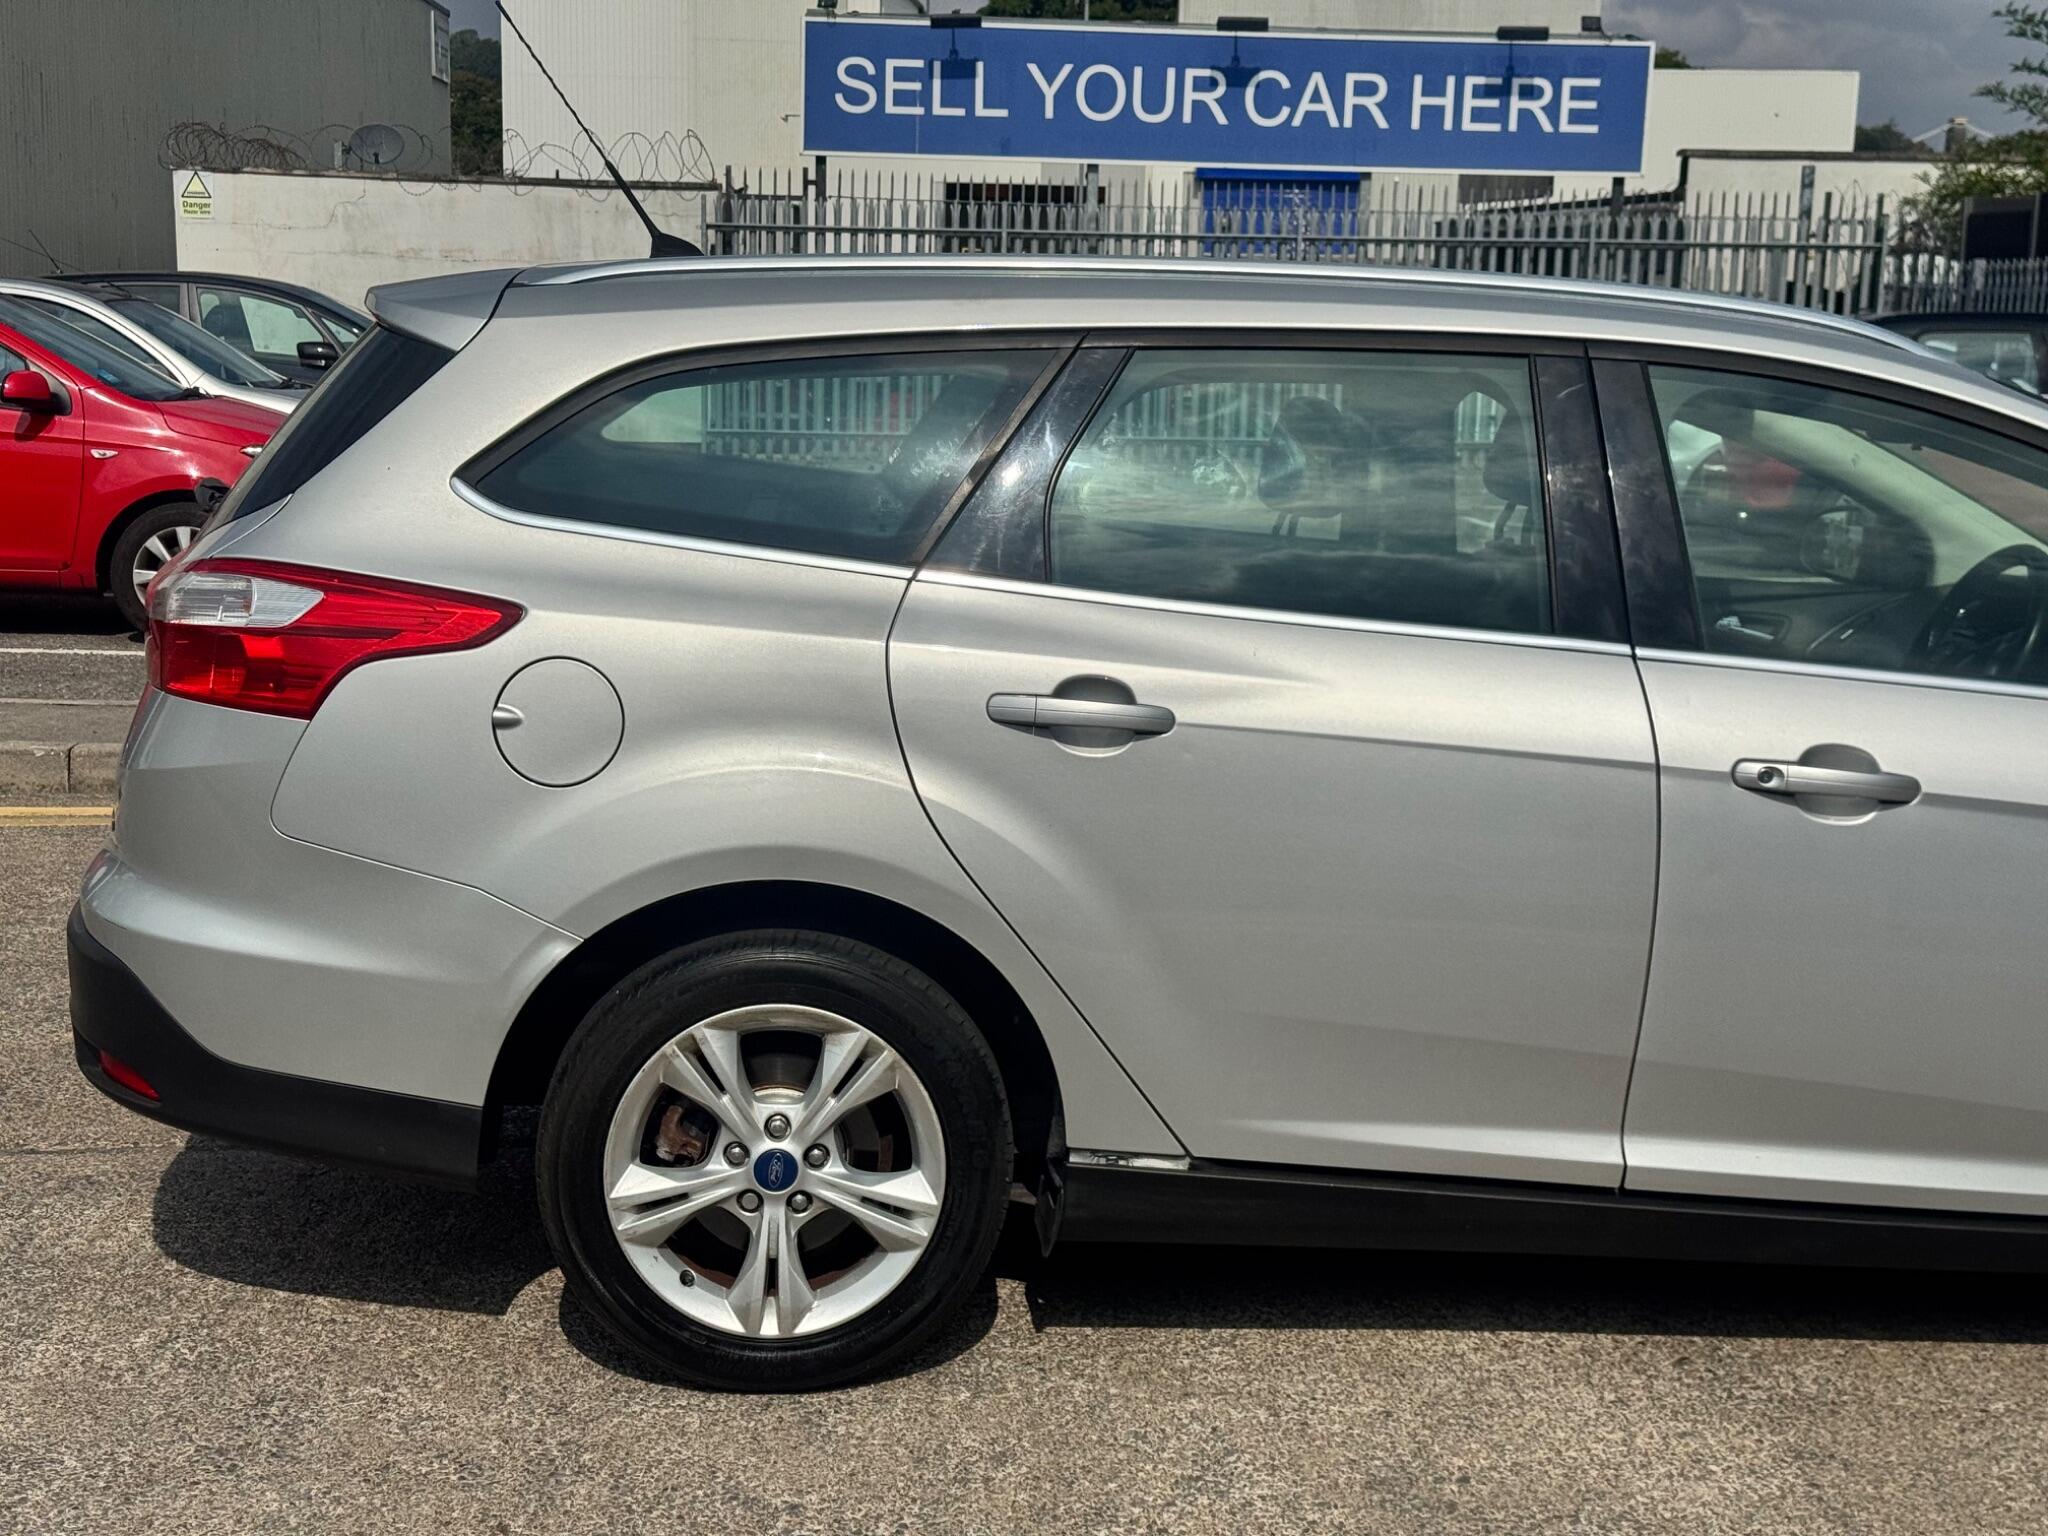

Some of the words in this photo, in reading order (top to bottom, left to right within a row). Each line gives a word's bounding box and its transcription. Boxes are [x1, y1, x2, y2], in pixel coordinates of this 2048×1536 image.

[834, 55, 1010, 118] SELL
[1026, 63, 1229, 126] YOUR
[1244, 69, 1390, 130] CAR
[1410, 73, 1602, 134] HERE
[182, 200, 211, 210] Danger
